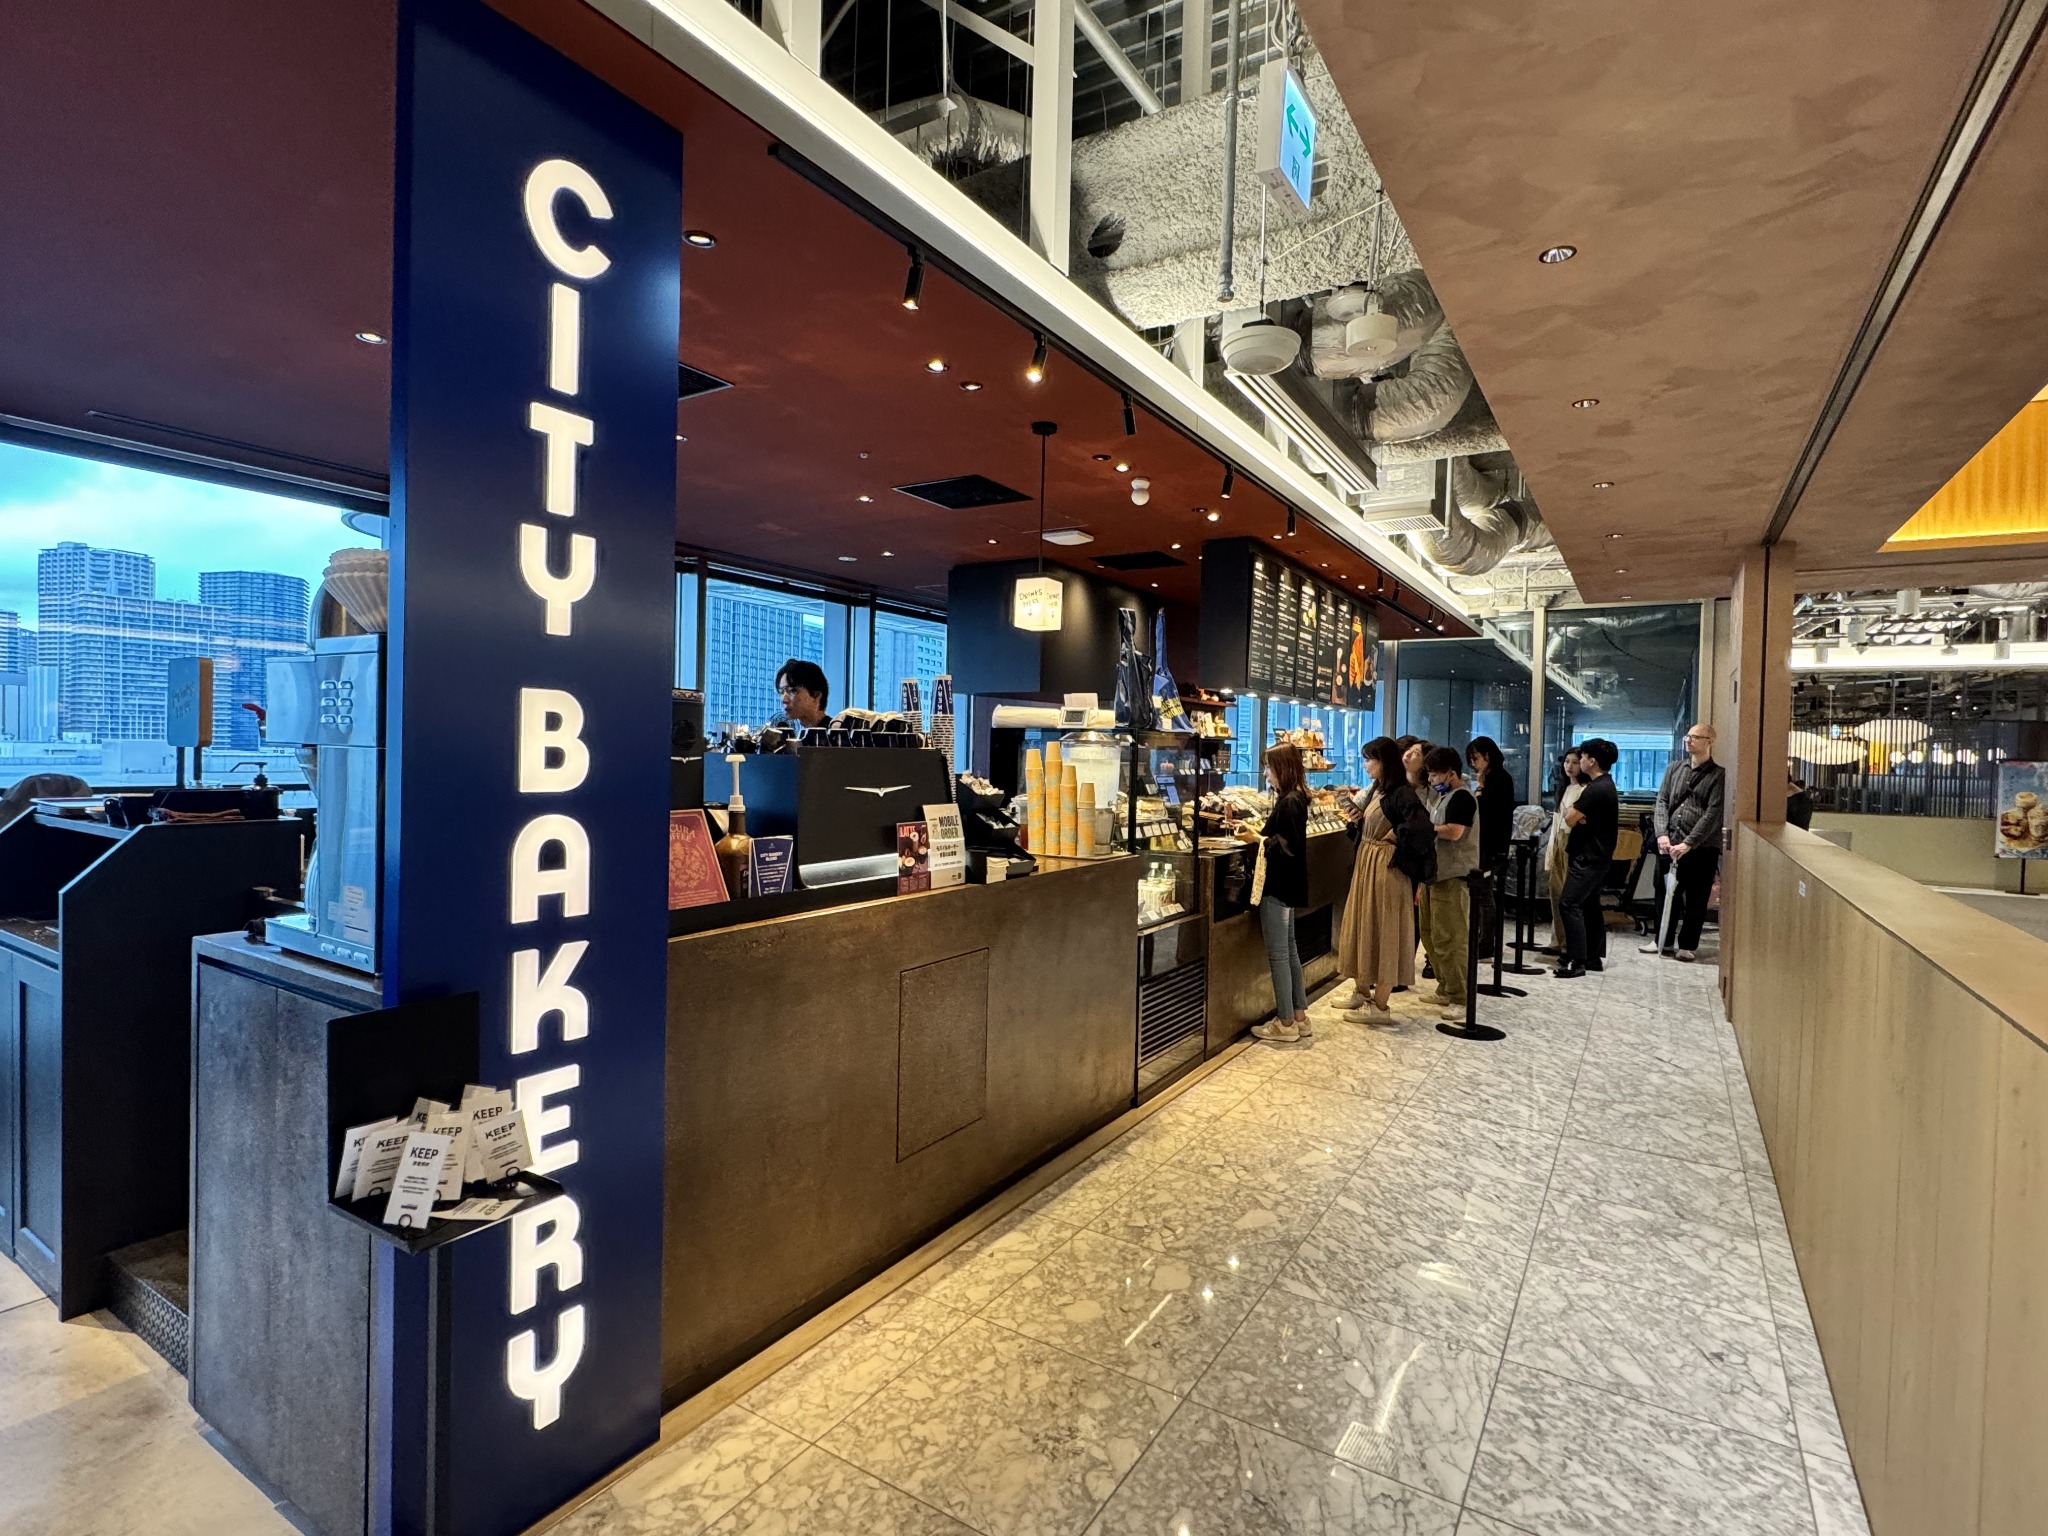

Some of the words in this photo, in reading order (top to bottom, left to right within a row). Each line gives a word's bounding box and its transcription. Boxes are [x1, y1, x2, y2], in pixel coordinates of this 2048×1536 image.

[519, 158, 614, 637] CITY
[938, 814, 960, 828] MOBILE
[941, 827, 960, 840] ORDER
[506, 686, 591, 1431] BAKERY
[473, 1106, 502, 1120] KEEP
[485, 1122, 516, 1140] KEEP
[410, 1146, 439, 1160] KEEP
